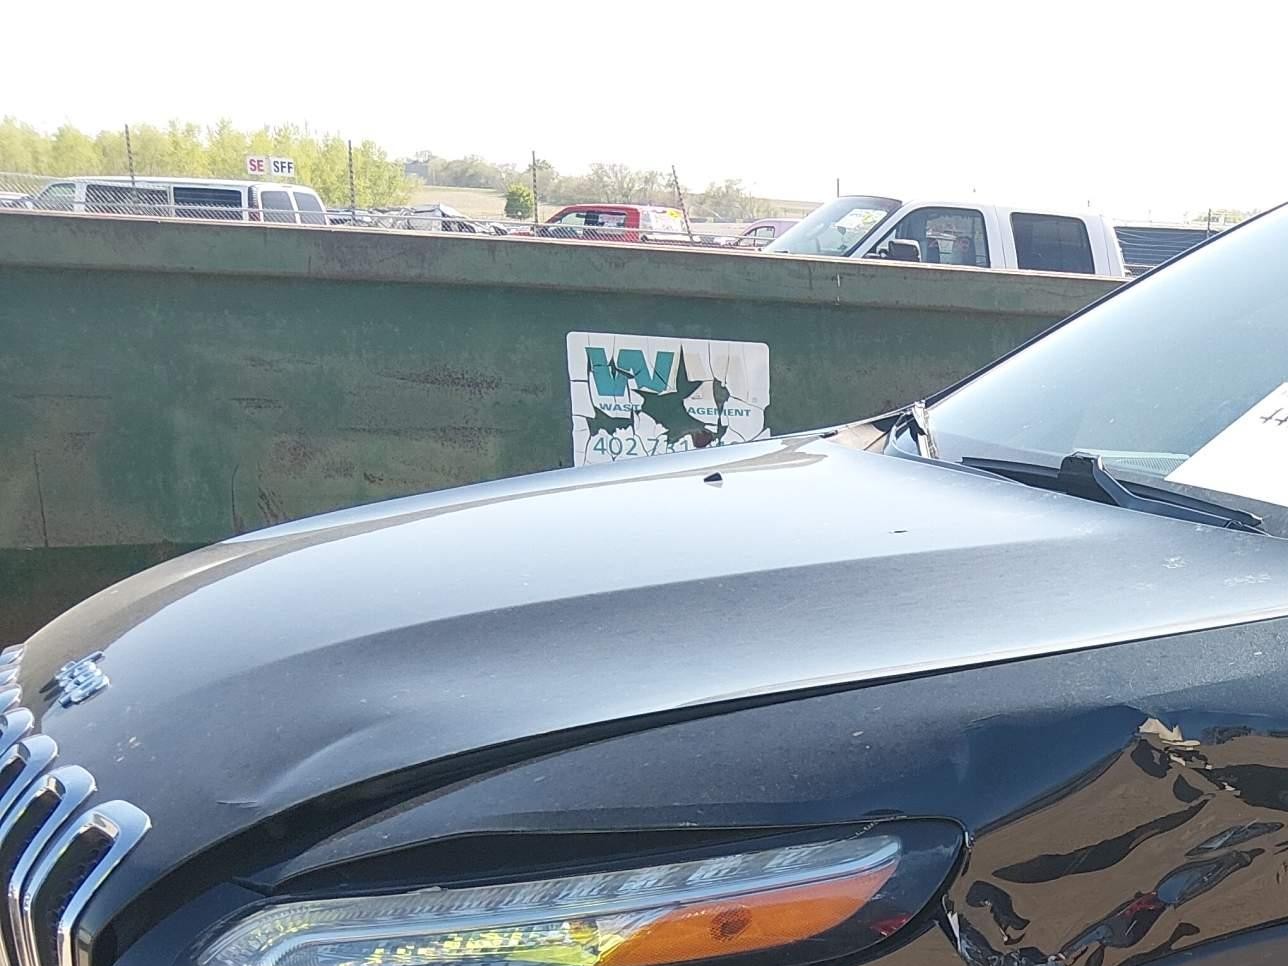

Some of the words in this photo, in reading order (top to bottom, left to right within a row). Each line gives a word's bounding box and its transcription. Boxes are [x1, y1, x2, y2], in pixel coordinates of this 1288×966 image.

[249, 158, 265, 172] SE
[273, 160, 294, 173] SFF
[600, 402, 641, 413] WAST
[593, 437, 638, 456] 402
